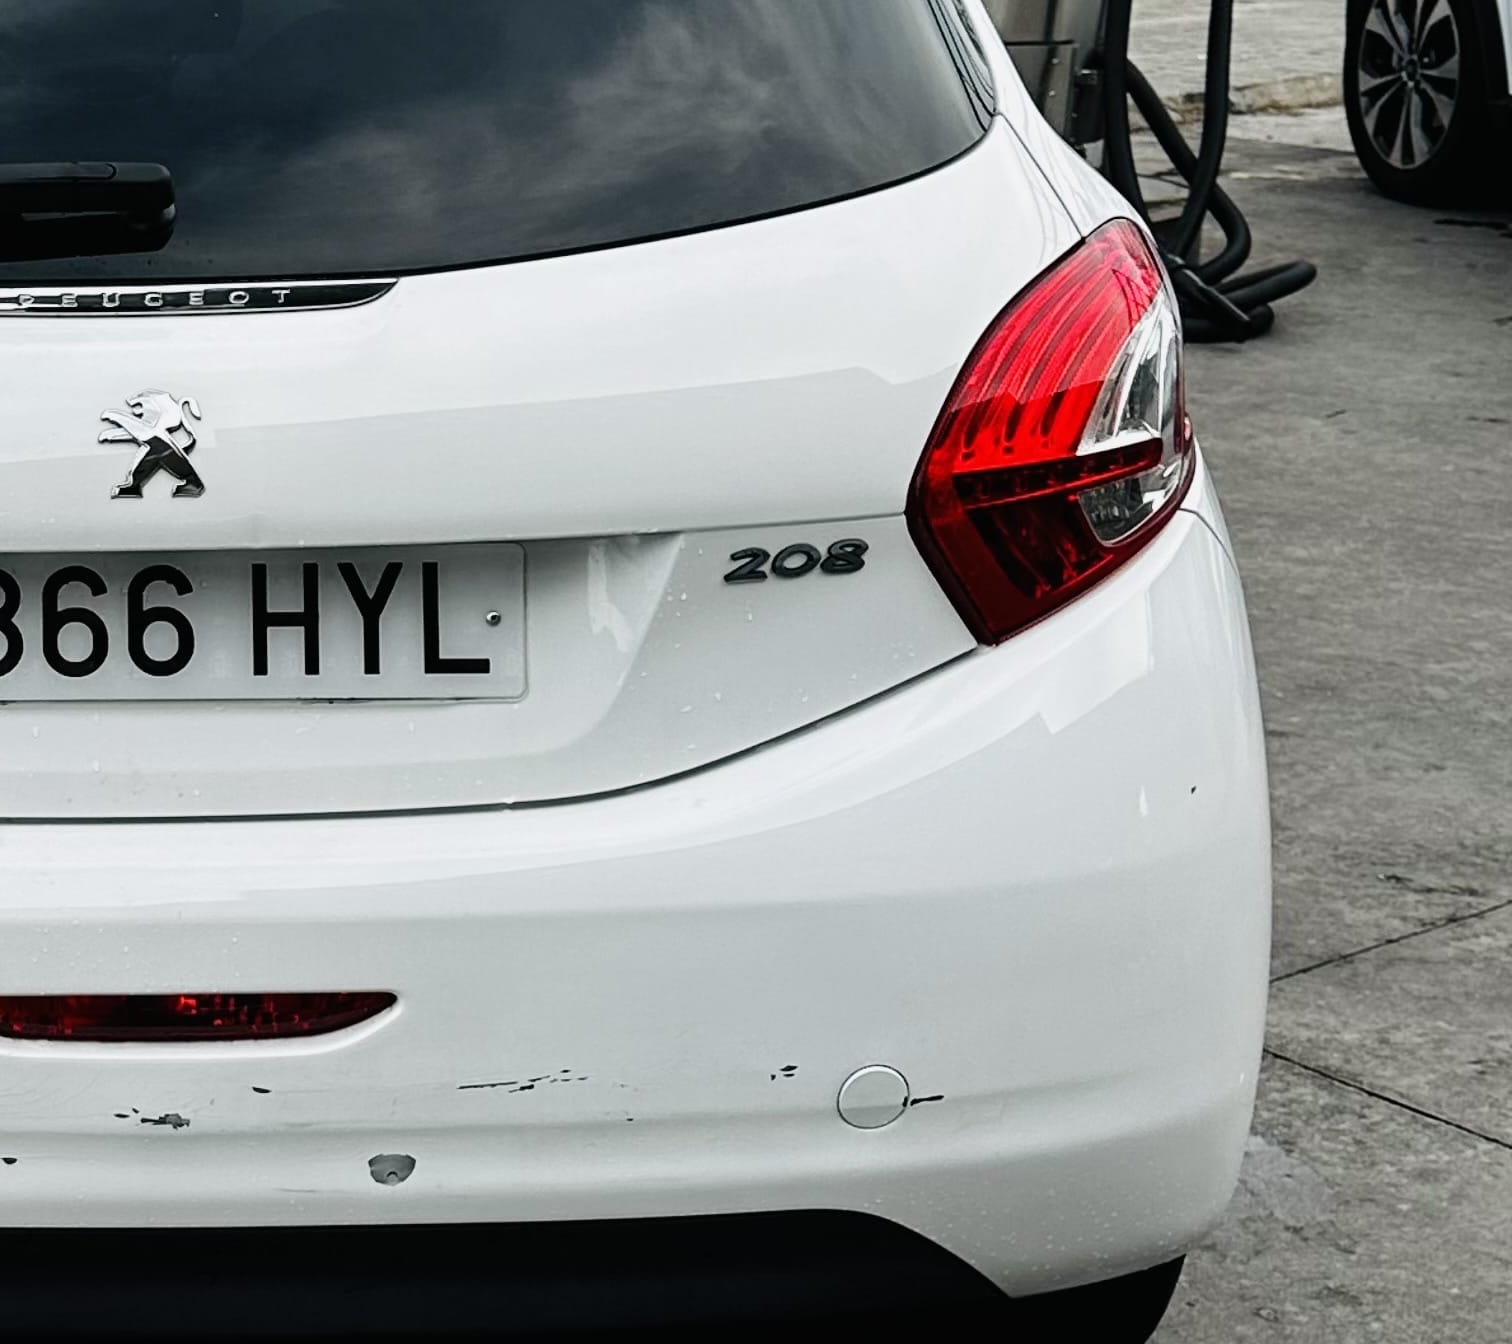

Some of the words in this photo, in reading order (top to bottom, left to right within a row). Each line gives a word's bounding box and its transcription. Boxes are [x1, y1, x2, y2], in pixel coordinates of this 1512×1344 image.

[17, 287, 292, 308] PEUGEOT
[723, 537, 870, 584] 208
[251, 560, 492, 677] HYL
